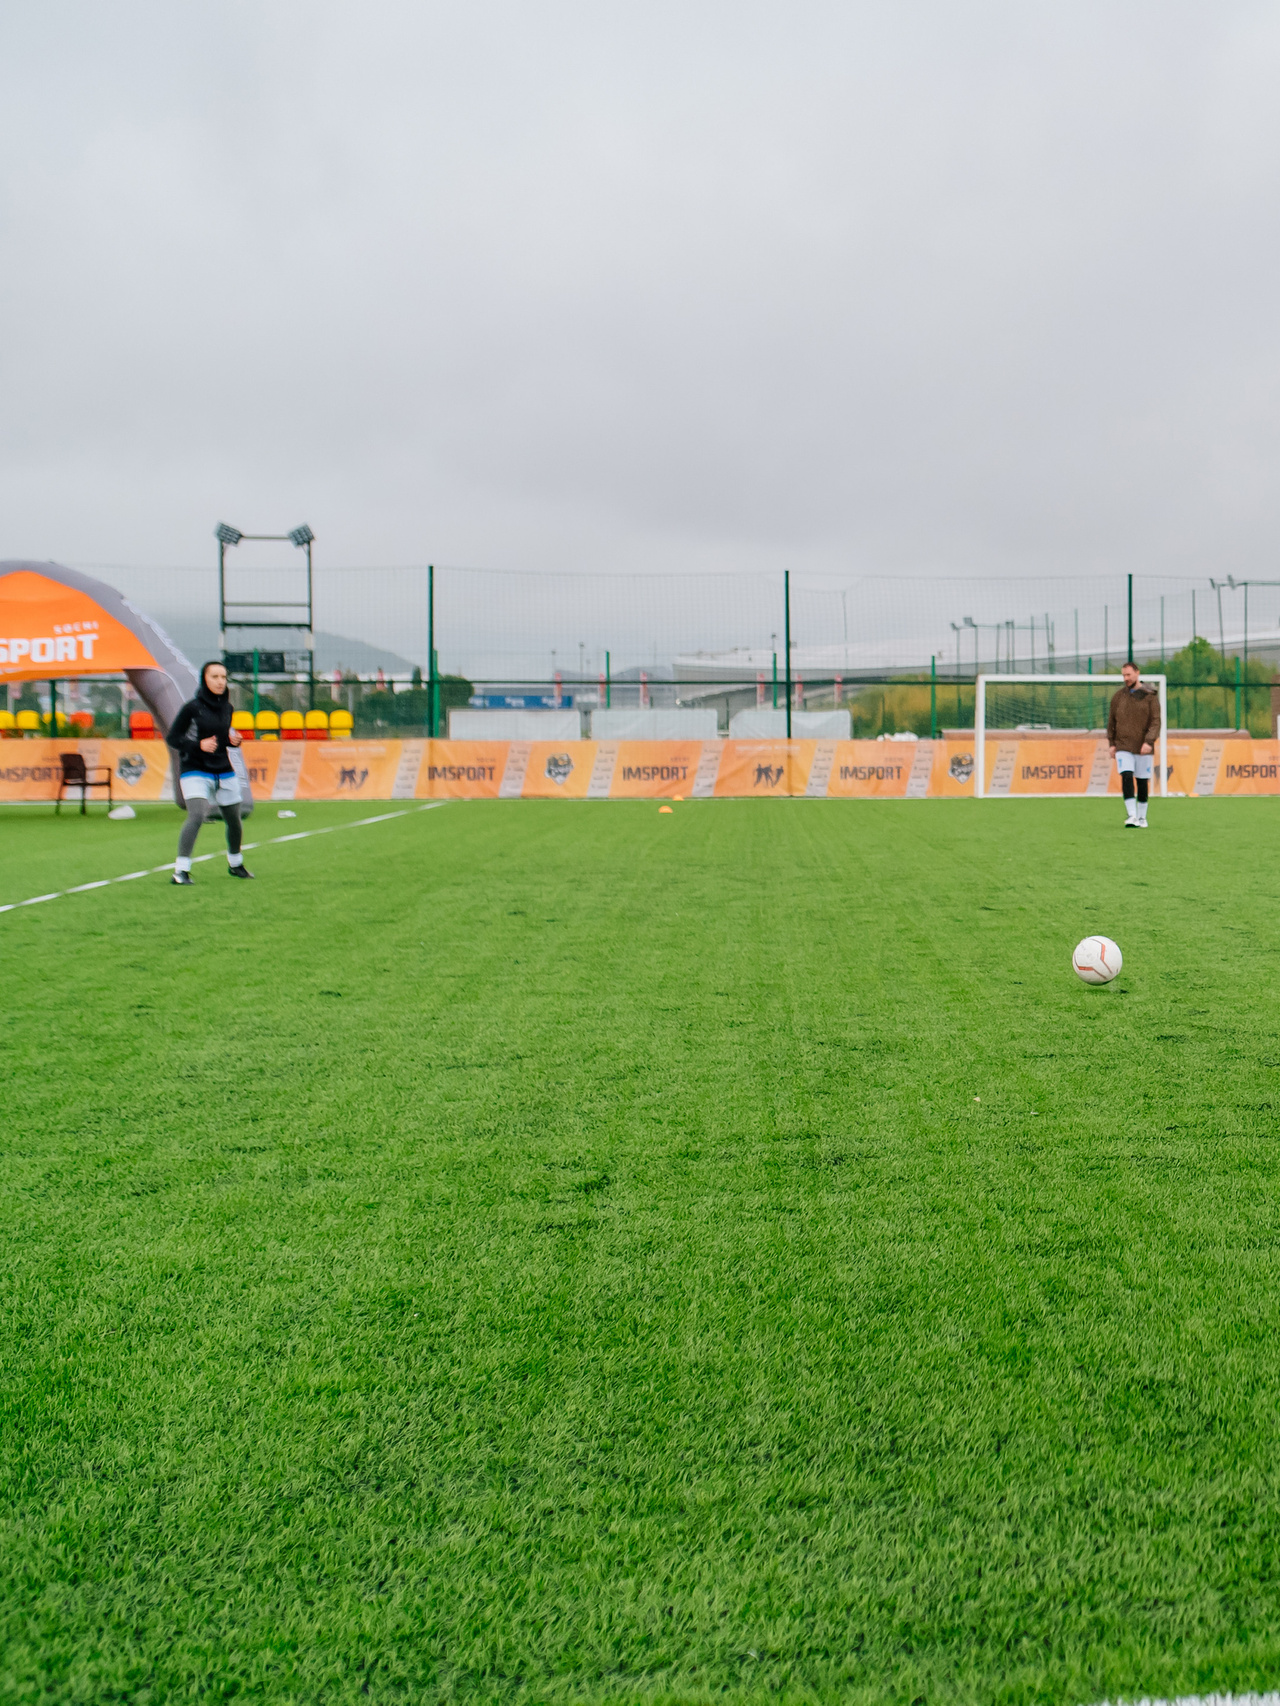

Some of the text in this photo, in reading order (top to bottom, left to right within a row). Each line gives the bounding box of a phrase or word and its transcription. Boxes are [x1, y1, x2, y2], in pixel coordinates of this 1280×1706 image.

[53, 620, 99, 635] SOCHI
[428, 766, 496, 781] IMSPORT
[622, 766, 689, 781] IMSPORT
[840, 765, 903, 780] IMSPORT
[1022, 765, 1084, 780] IMSPORT
